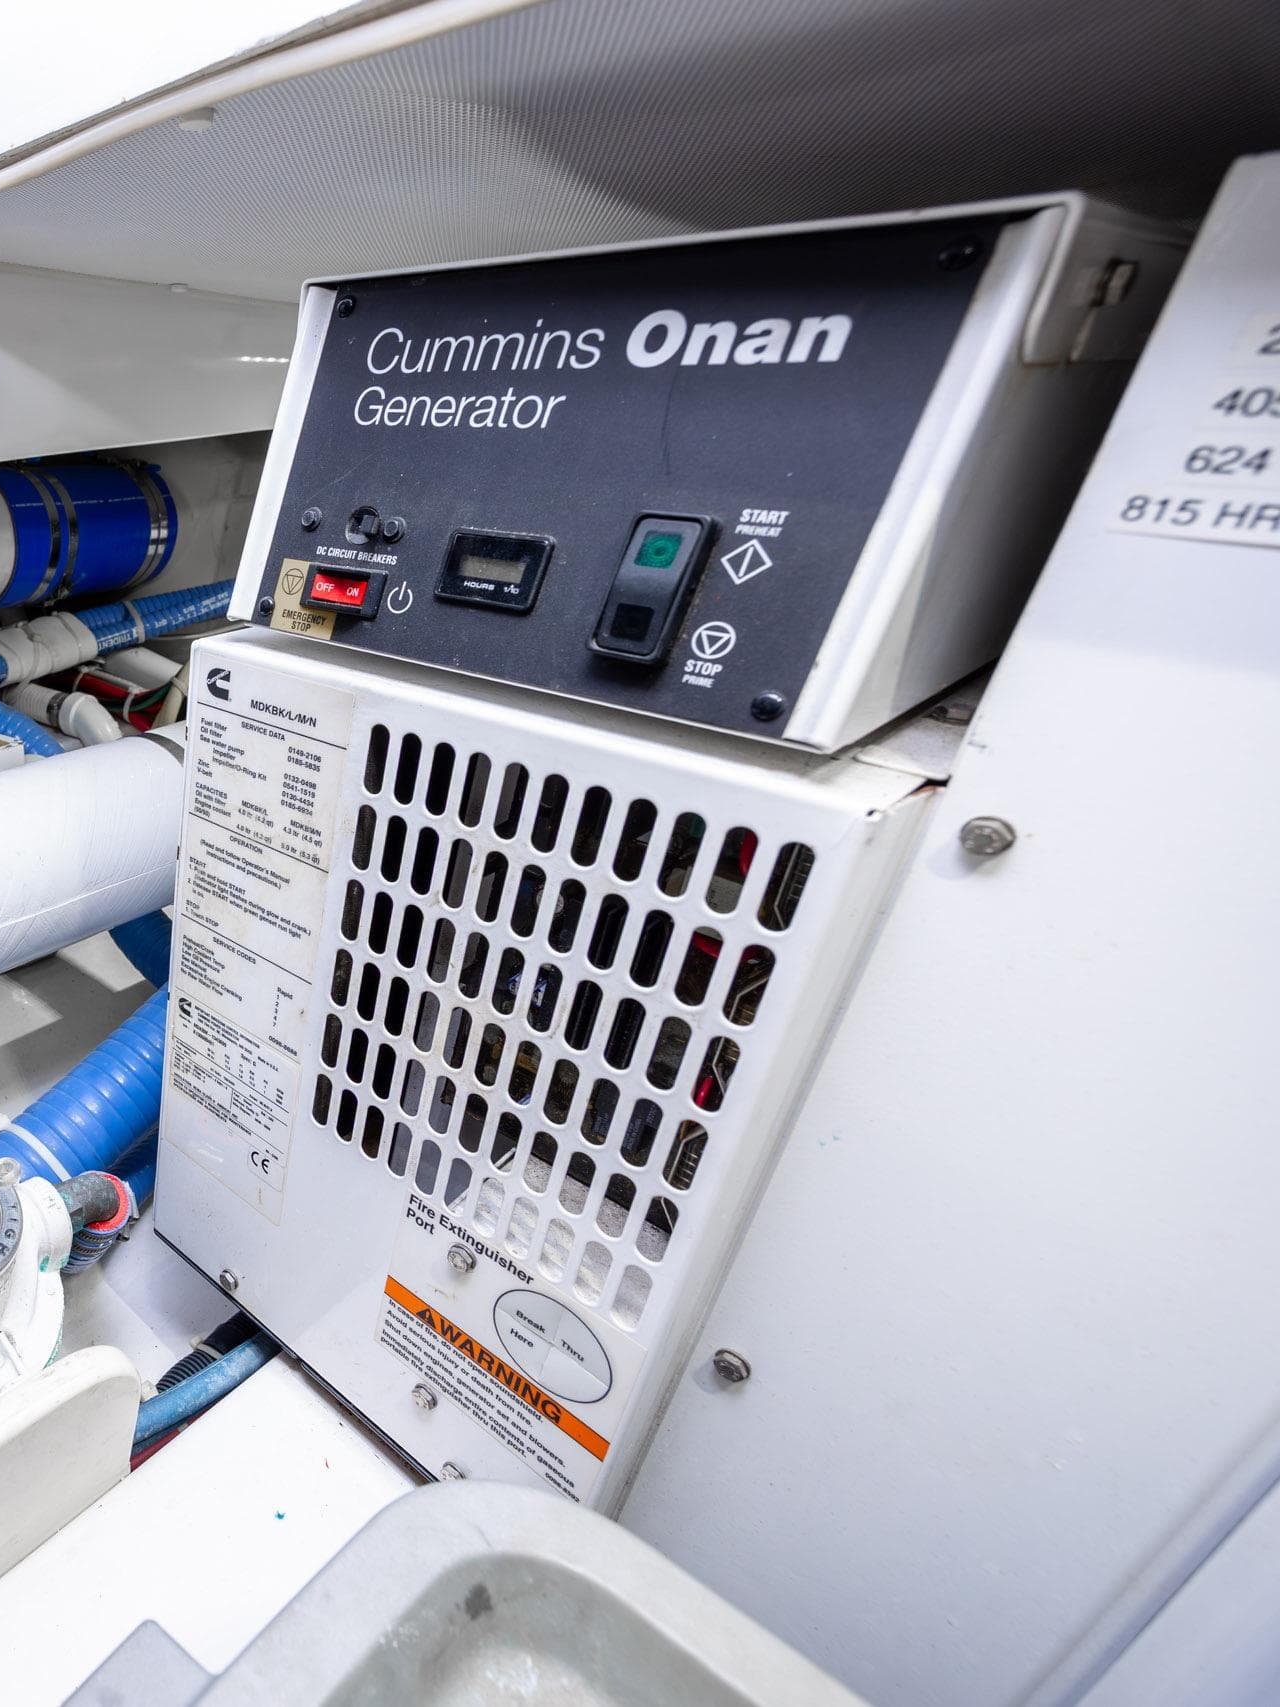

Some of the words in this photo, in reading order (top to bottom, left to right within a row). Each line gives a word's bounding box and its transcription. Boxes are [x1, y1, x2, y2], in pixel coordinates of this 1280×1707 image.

[366, 319, 606, 375] Cummins
[625, 309, 854, 369] Onan
[353, 386, 566, 429] Generator
[1213, 386, 1280, 418] 40
[1184, 445, 1271, 475] 624
[739, 508, 791, 526] START
[1120, 495, 1201, 526] 815
[734, 524, 783, 538] PREHEAT
[316, 545, 327, 555] DC
[328, 547, 356, 560] CIRCUIT
[357, 551, 398, 566] BREAKERS
[315, 582, 335, 593] OFF
[346, 586, 360, 597] ON
[463, 580, 496, 591] HOURS
[282, 608, 326, 626] EMERGENCY
[291, 620, 311, 632] STOP
[684, 659, 723, 676] STOP
[681, 674, 715, 688] PRIME
[200, 717, 213, 726] Fuel
[241, 721, 267, 735] SERVICE
[268, 730, 285, 741] DATA
[227, 745, 245, 756] pump
[229, 835, 263, 854] OPERATION
[228, 883, 246, 895] START
[212, 936, 235, 953] SERVICE
[236, 949, 256, 964] CODES
[406, 1207, 434, 1234] Port
[409, 1193, 435, 1219] Fire
[439, 1214, 533, 1283] Extinguisher
[510, 1328, 533, 1347] Here
[516, 1310, 545, 1333] Break
[561, 1339, 584, 1362] Thru
[386, 1309, 407, 1328] Avoid
[408, 1327, 436, 1350] serious
[437, 1348, 459, 1369] injury
[460, 1367, 470, 1376] or
[470, 1376, 493, 1396] death
[495, 1394, 515, 1413] from
[516, 1411, 532, 1427] fire.
[397, 1306, 414, 1322] case
[415, 1320, 424, 1329] of
[424, 1326, 439, 1342] fire,
[440, 1340, 451, 1350] do
[452, 1349, 466, 1362] not
[467, 1361, 488, 1379] open
[489, 1378, 542, 1422] soundshield.
[440, 1319, 561, 1423] WARNING
[380, 1336, 409, 1361] portable
[410, 1359, 423, 1372] fire
[424, 1371, 471, 1410] extinguisher
[472, 1409, 489, 1426] thru
[490, 1424, 505, 1440] this
[506, 1439, 526, 1458] port.
[384, 1319, 401, 1335] Shut
[402, 1334, 422, 1352] down
[423, 1351, 454, 1379] engines,
[456, 1377, 495, 1409] generator
[496, 1409, 509, 1422] set
[510, 1421, 527, 1436] and
[528, 1434, 565, 1467] blowers.
[382, 1329, 424, 1366] Immediately
[429, 1366, 463, 1396] discharge
[464, 1396, 487, 1416] entire
[488, 1416, 524, 1447] contents
[526, 1446, 536, 1455] of
[536, 1455, 574, 1488] gaseous
